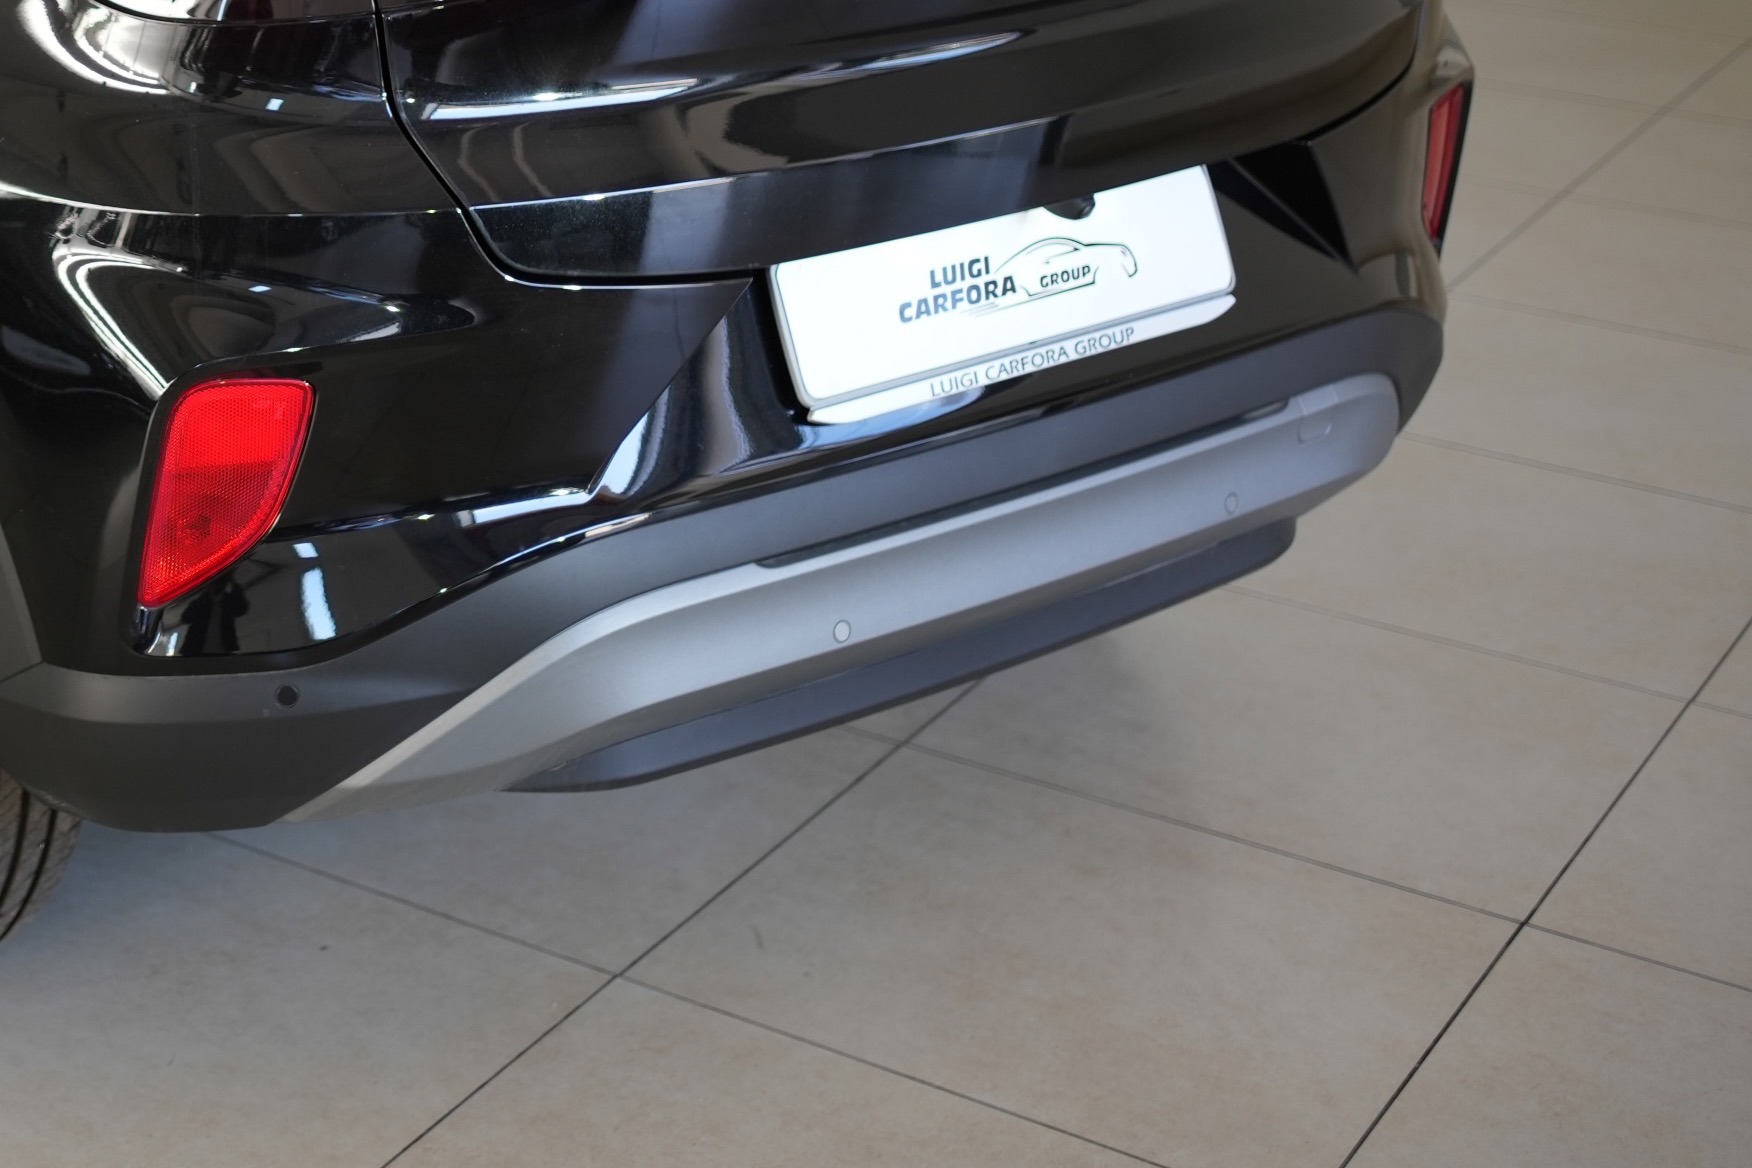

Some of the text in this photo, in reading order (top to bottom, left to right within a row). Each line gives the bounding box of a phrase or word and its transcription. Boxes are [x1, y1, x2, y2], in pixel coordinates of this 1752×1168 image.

[929, 255, 992, 290] LUIGI
[1038, 264, 1092, 289] GROUP
[898, 275, 1017, 324] CARFORA
[930, 325, 1137, 398] LUIGI CARFORA GROUP
